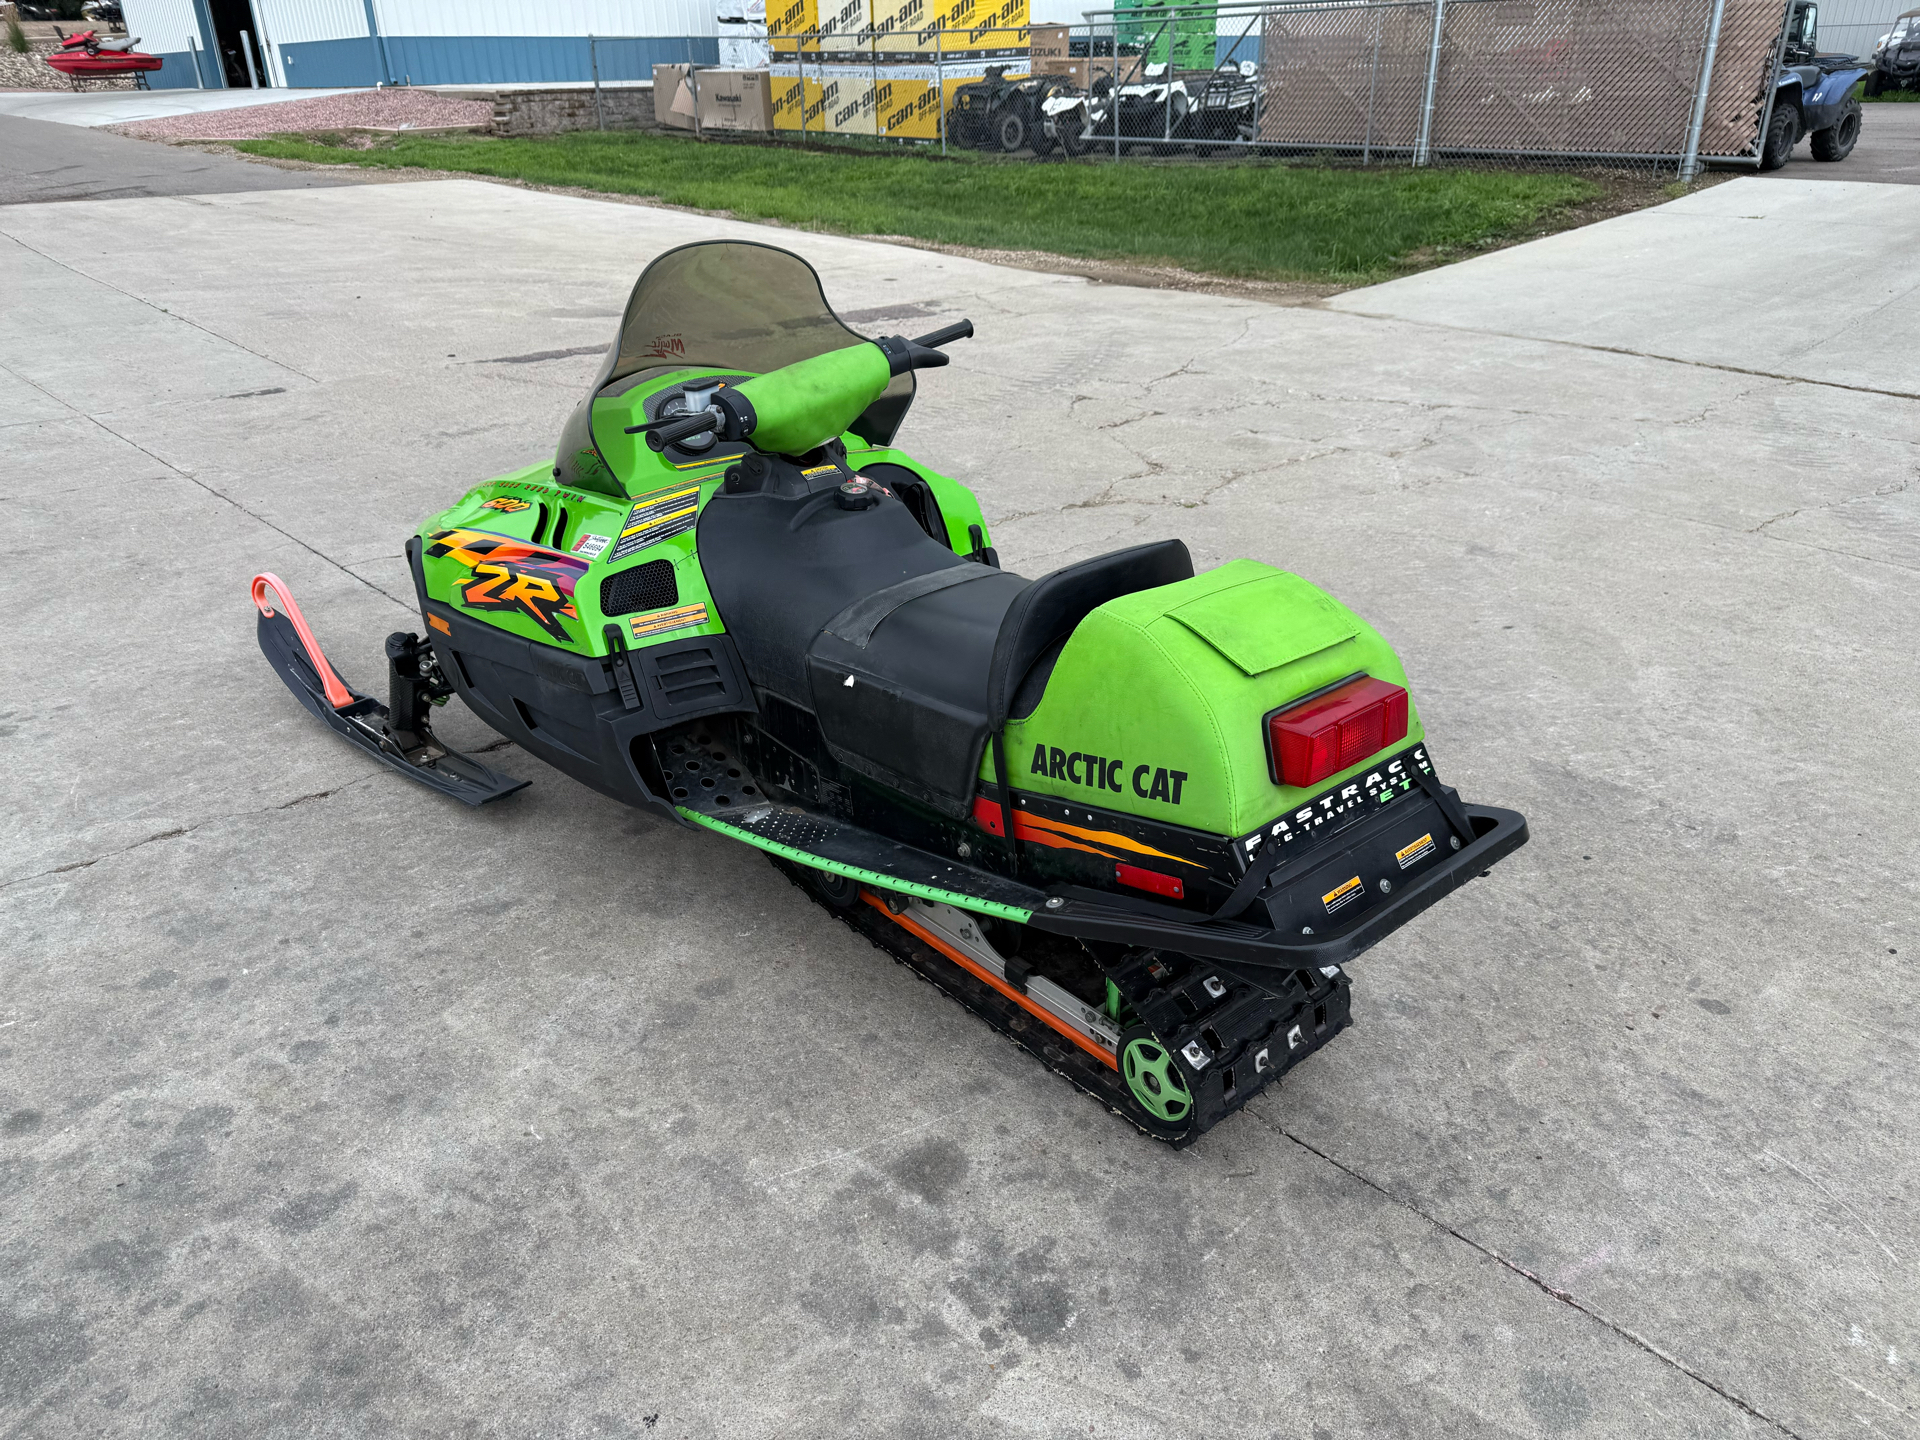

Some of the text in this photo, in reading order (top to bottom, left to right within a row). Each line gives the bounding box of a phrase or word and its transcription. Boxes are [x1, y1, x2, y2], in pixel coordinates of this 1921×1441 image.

[767, 0, 804, 41] an-am
[900, 11, 923, 34] OFF-ROAD
[918, 0, 975, 46] can-am
[1030, 48, 1061, 56] UZUKI
[715, 93, 742, 102] Kawasaki
[480, 497, 532, 513] 600
[554, 490, 586, 503] TWIN
[462, 562, 571, 640] ZR
[1031, 744, 1188, 805] ARCTIC CAT
[1245, 749, 1425, 852] FASTRACK
[1249, 796, 1364, 862] LG-TRAVEL
[1369, 760, 1428, 797] SYSTM
